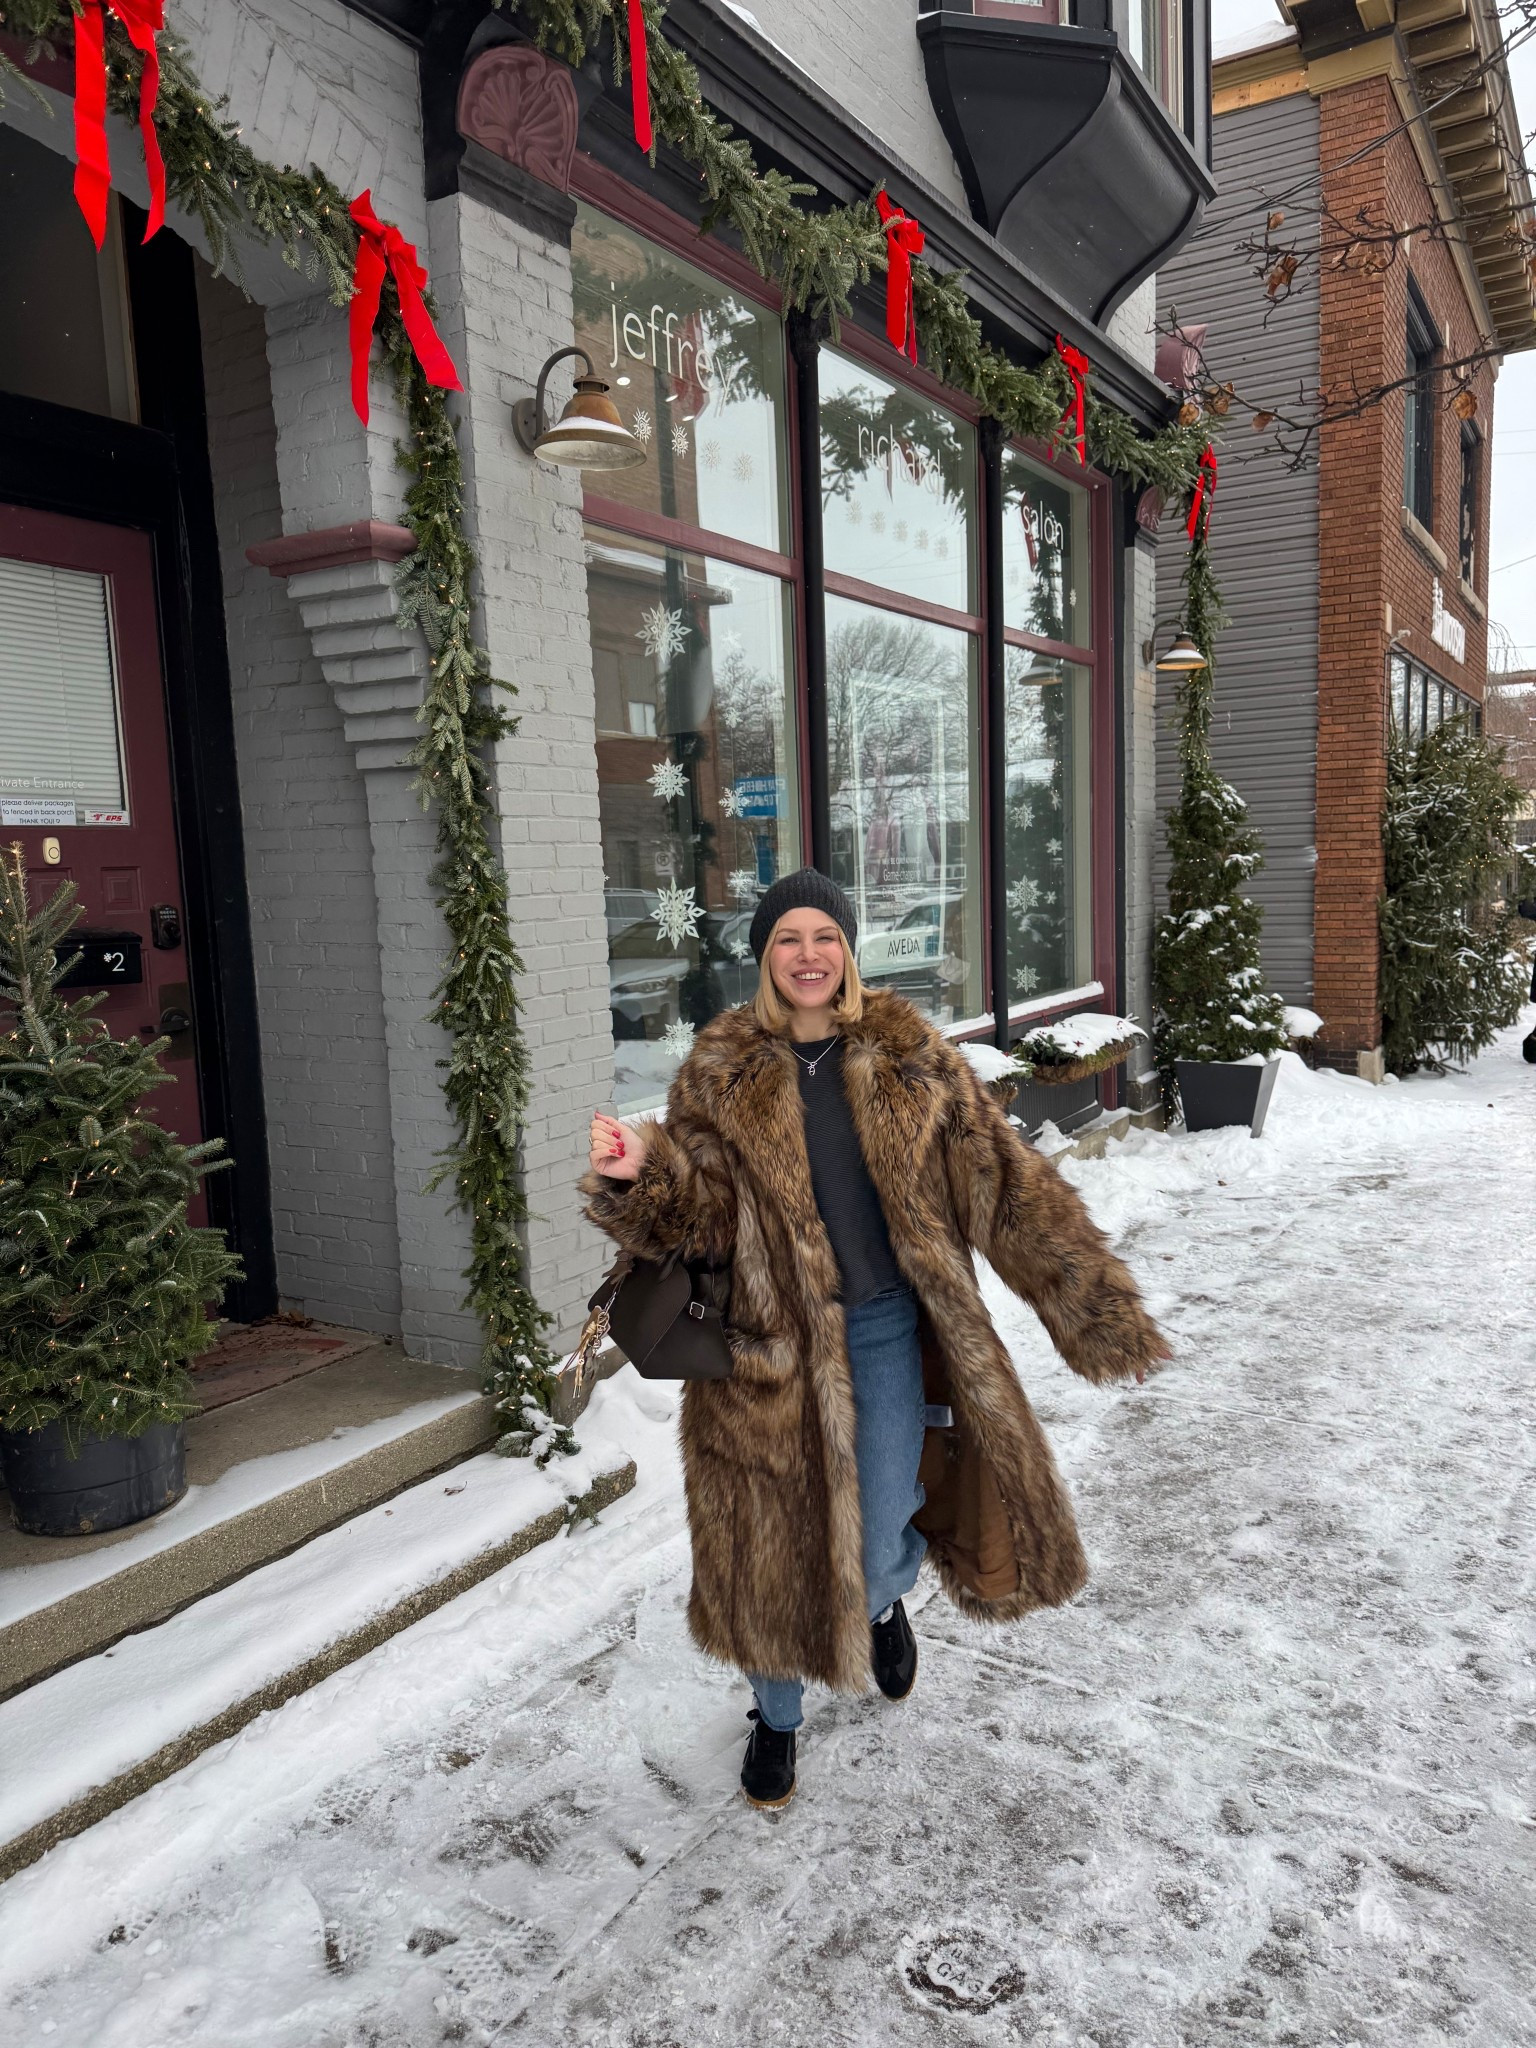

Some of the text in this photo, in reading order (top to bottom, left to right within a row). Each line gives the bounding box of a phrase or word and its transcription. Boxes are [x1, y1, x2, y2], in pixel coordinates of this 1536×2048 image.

[610, 281, 1063, 550] jeffrey richard salon
[0, 775, 85, 789] ivate Entrance
[44, 800, 74, 808] packages
[887, 937, 920, 958] AVEDA
